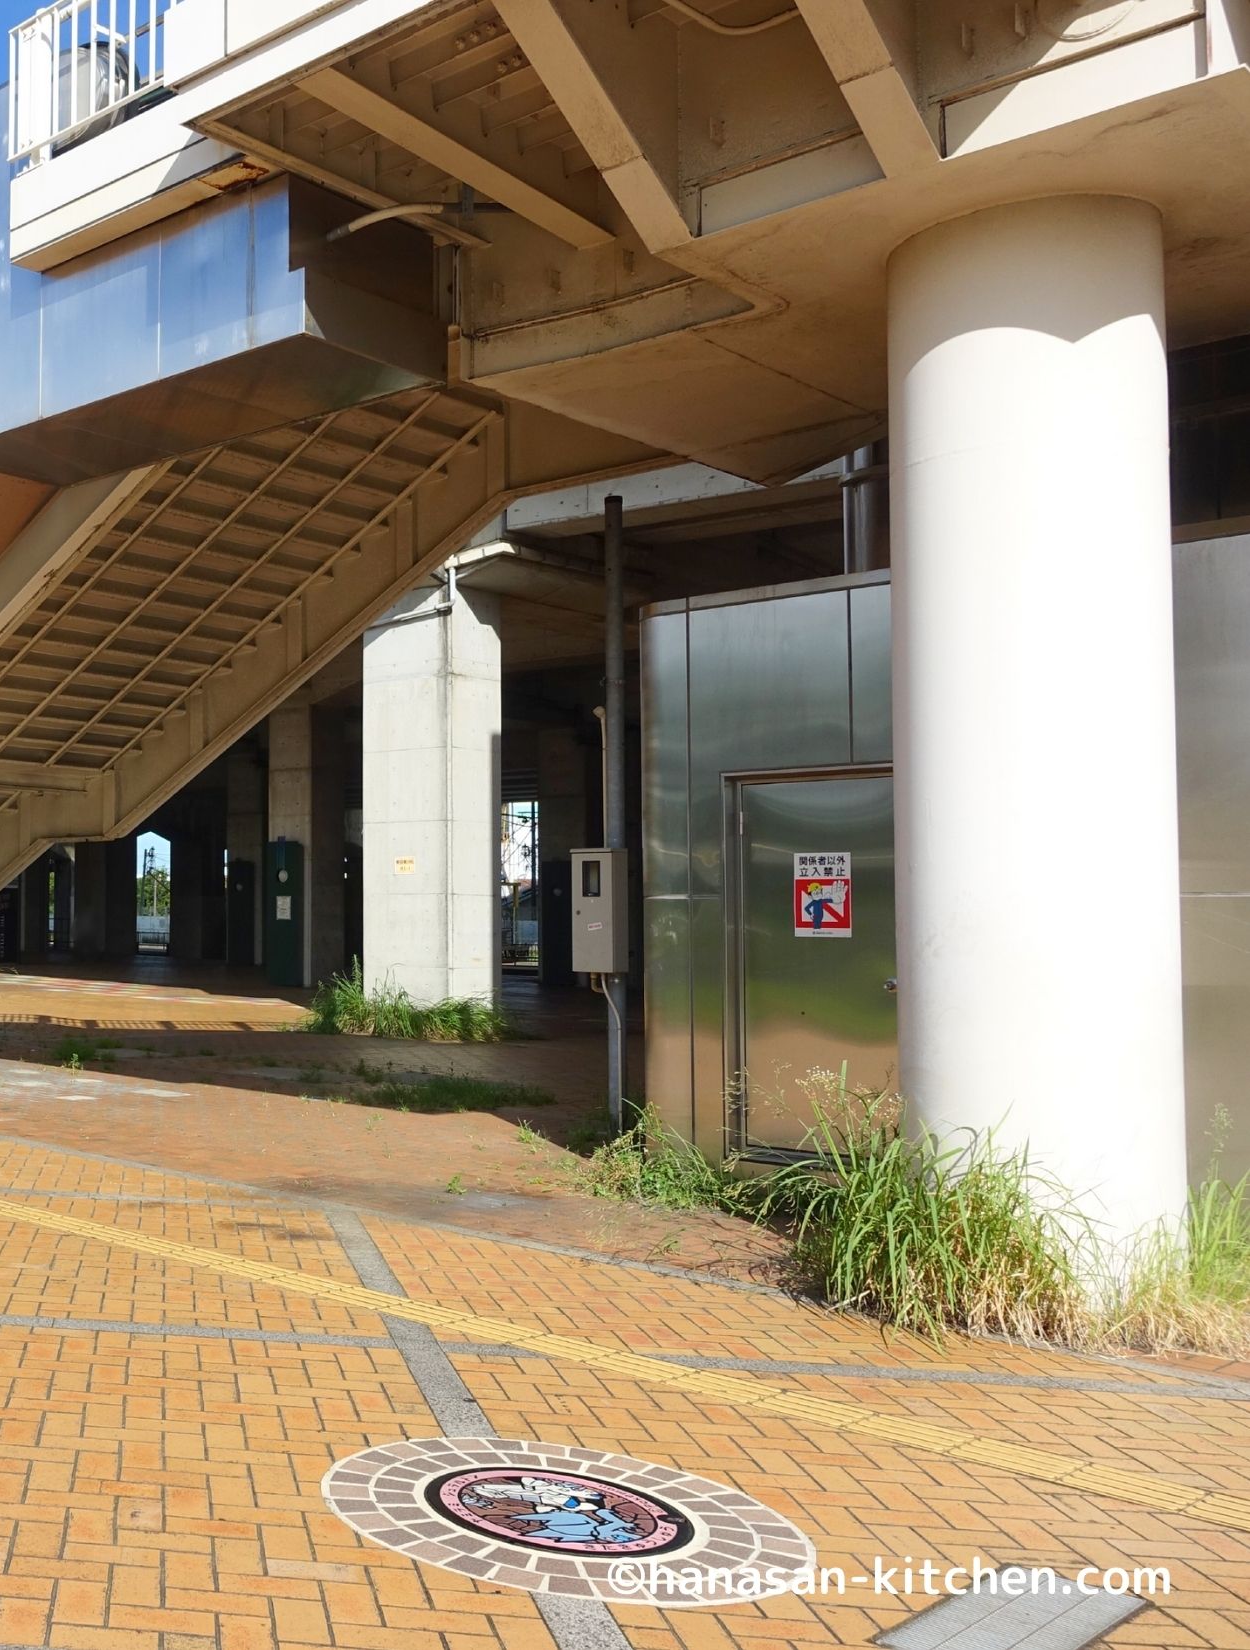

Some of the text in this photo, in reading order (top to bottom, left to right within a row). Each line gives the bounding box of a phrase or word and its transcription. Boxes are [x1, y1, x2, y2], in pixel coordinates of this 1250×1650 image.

[799, 856, 846, 866] 関係者以外
[799, 867, 846, 877] 立入禁止
[583, 1525, 675, 1551] きたきゅうしゅう
